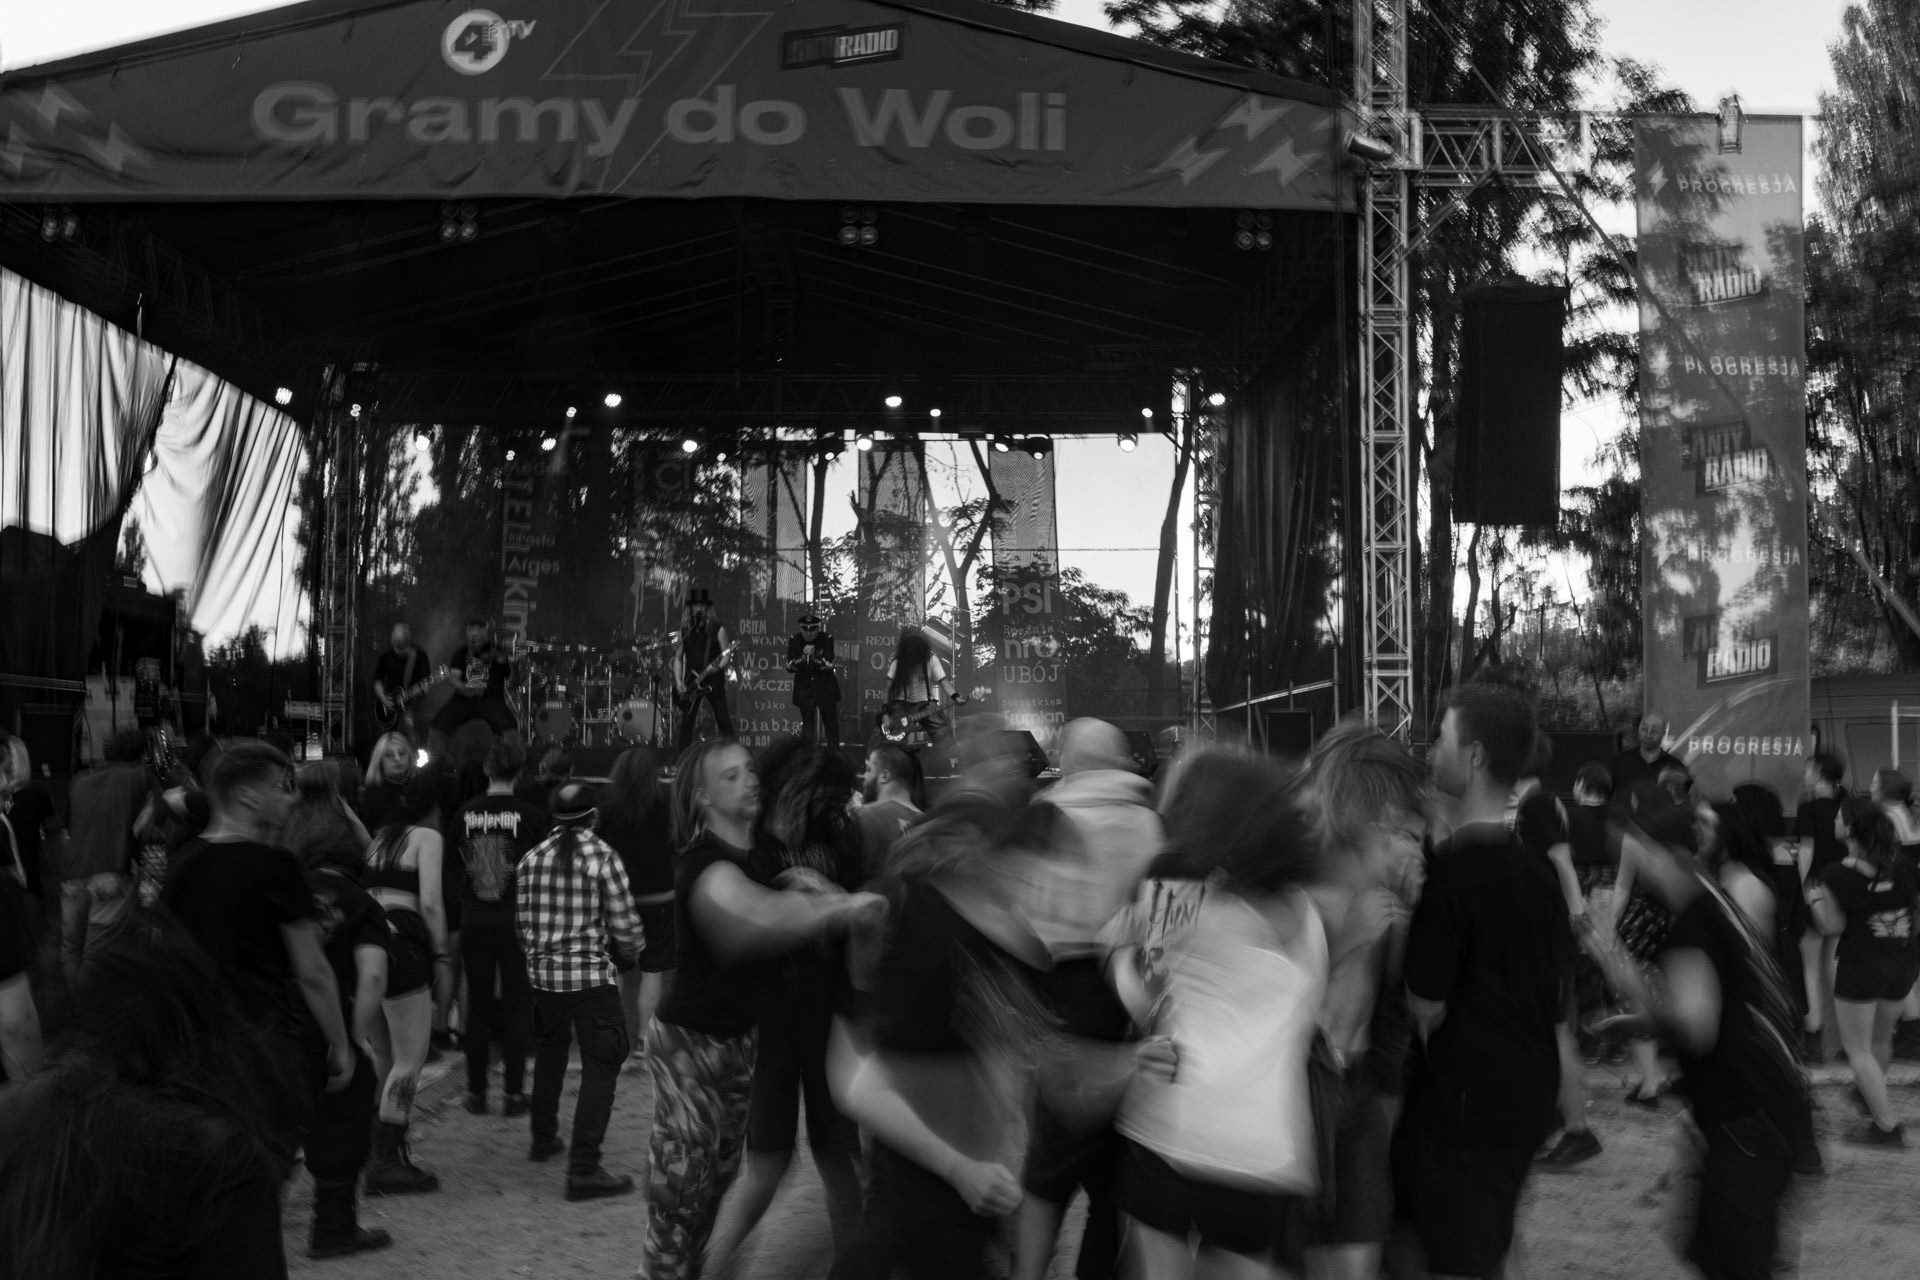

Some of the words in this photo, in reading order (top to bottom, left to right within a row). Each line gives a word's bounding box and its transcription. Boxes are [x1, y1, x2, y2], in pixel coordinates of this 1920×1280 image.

[834, 29, 899, 58] RADIO
[250, 81, 641, 158] Gramy
[666, 85, 807, 146] do
[837, 87, 1067, 152] Woli
[1677, 175, 1797, 195] PROGRESJA
[1699, 266, 1762, 302] RADIO
[1705, 449, 1768, 488] RADIO
[1003, 661, 1060, 683] UBÓJ
[1706, 639, 1771, 678] RADIO
[1686, 737, 1804, 757] PROGRESJA
